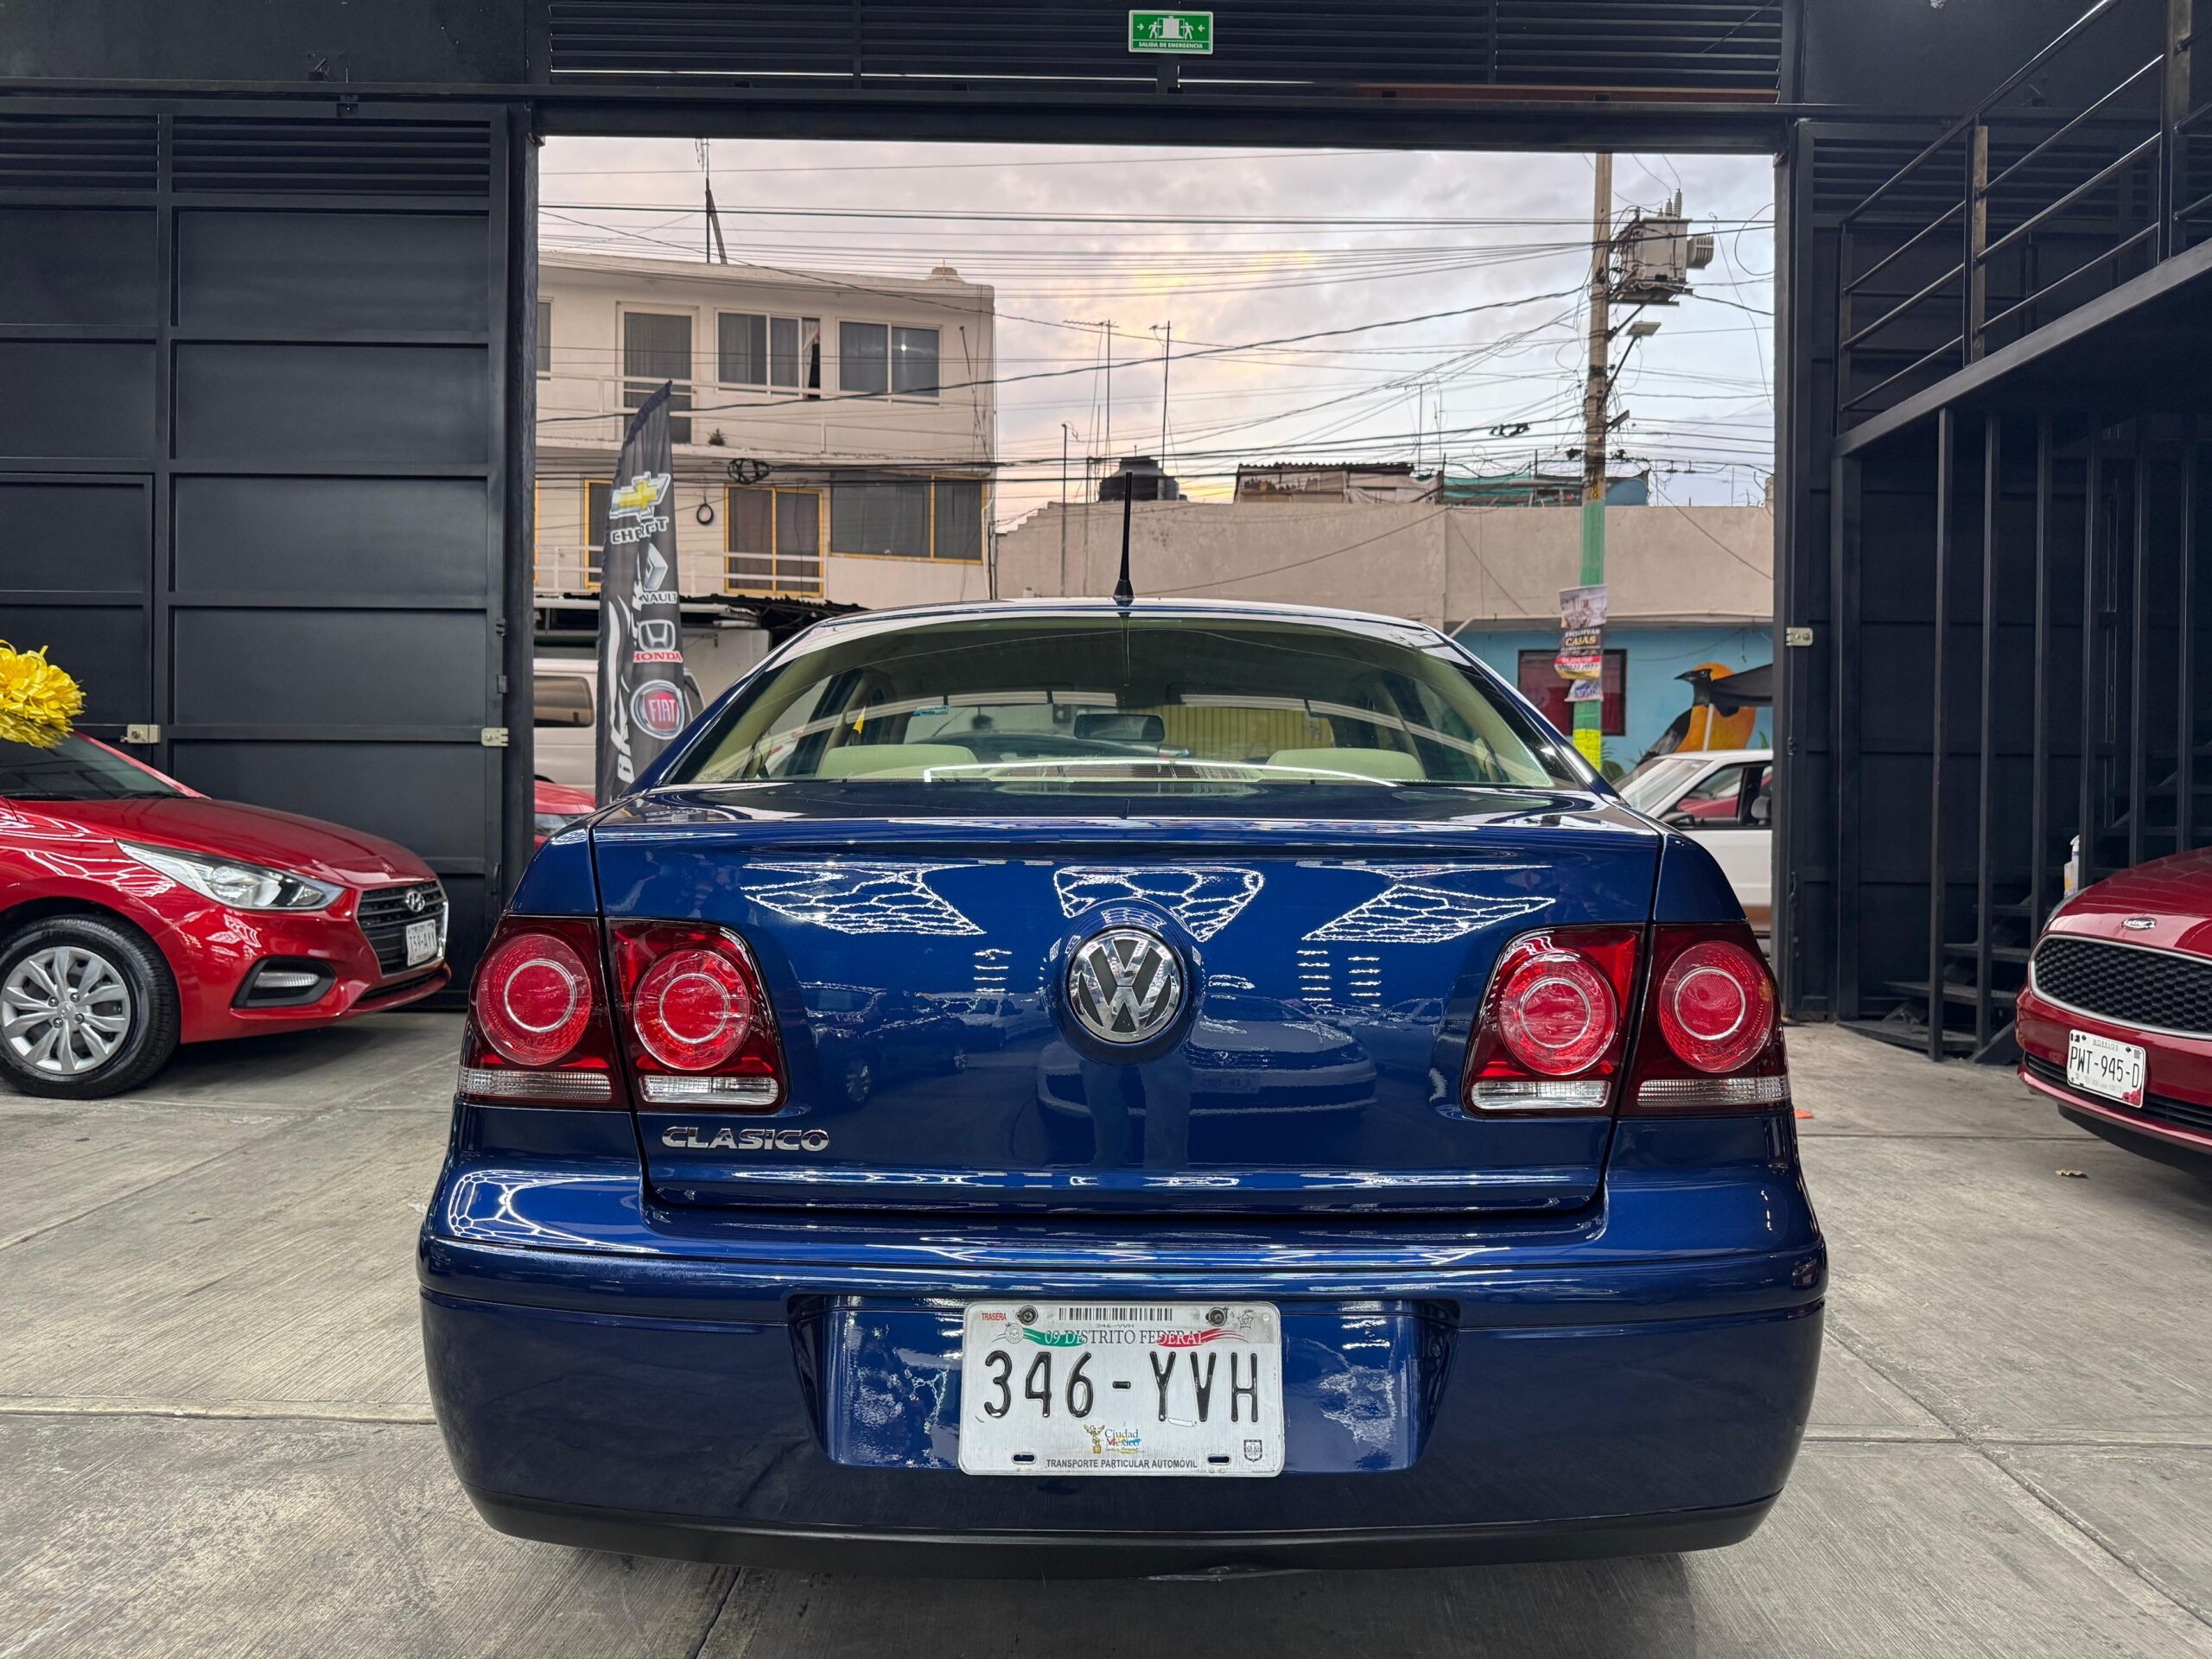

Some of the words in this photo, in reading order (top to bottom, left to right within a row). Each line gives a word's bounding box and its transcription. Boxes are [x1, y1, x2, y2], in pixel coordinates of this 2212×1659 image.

[648, 699, 676, 723] FIAT
[2069, 1046, 2140, 1088] PWT-945-D
[662, 1126, 830, 1152] CLASICO
[981, 1313, 1007, 1321] TRASERA
[1045, 1330, 1061, 1344] 09
[1065, 1330, 1136, 1344] DISTRITO
[1141, 1330, 1205, 1344] FEDERAL
[983, 1350, 1258, 1423] 346-YVH
[1104, 1428, 1139, 1438] Ciudad
[1046, 1459, 1098, 1468] TRANSPORTE
[1101, 1459, 1150, 1469] PARTICULAR
[1152, 1457, 1198, 1468] AUTOMÓVIL
